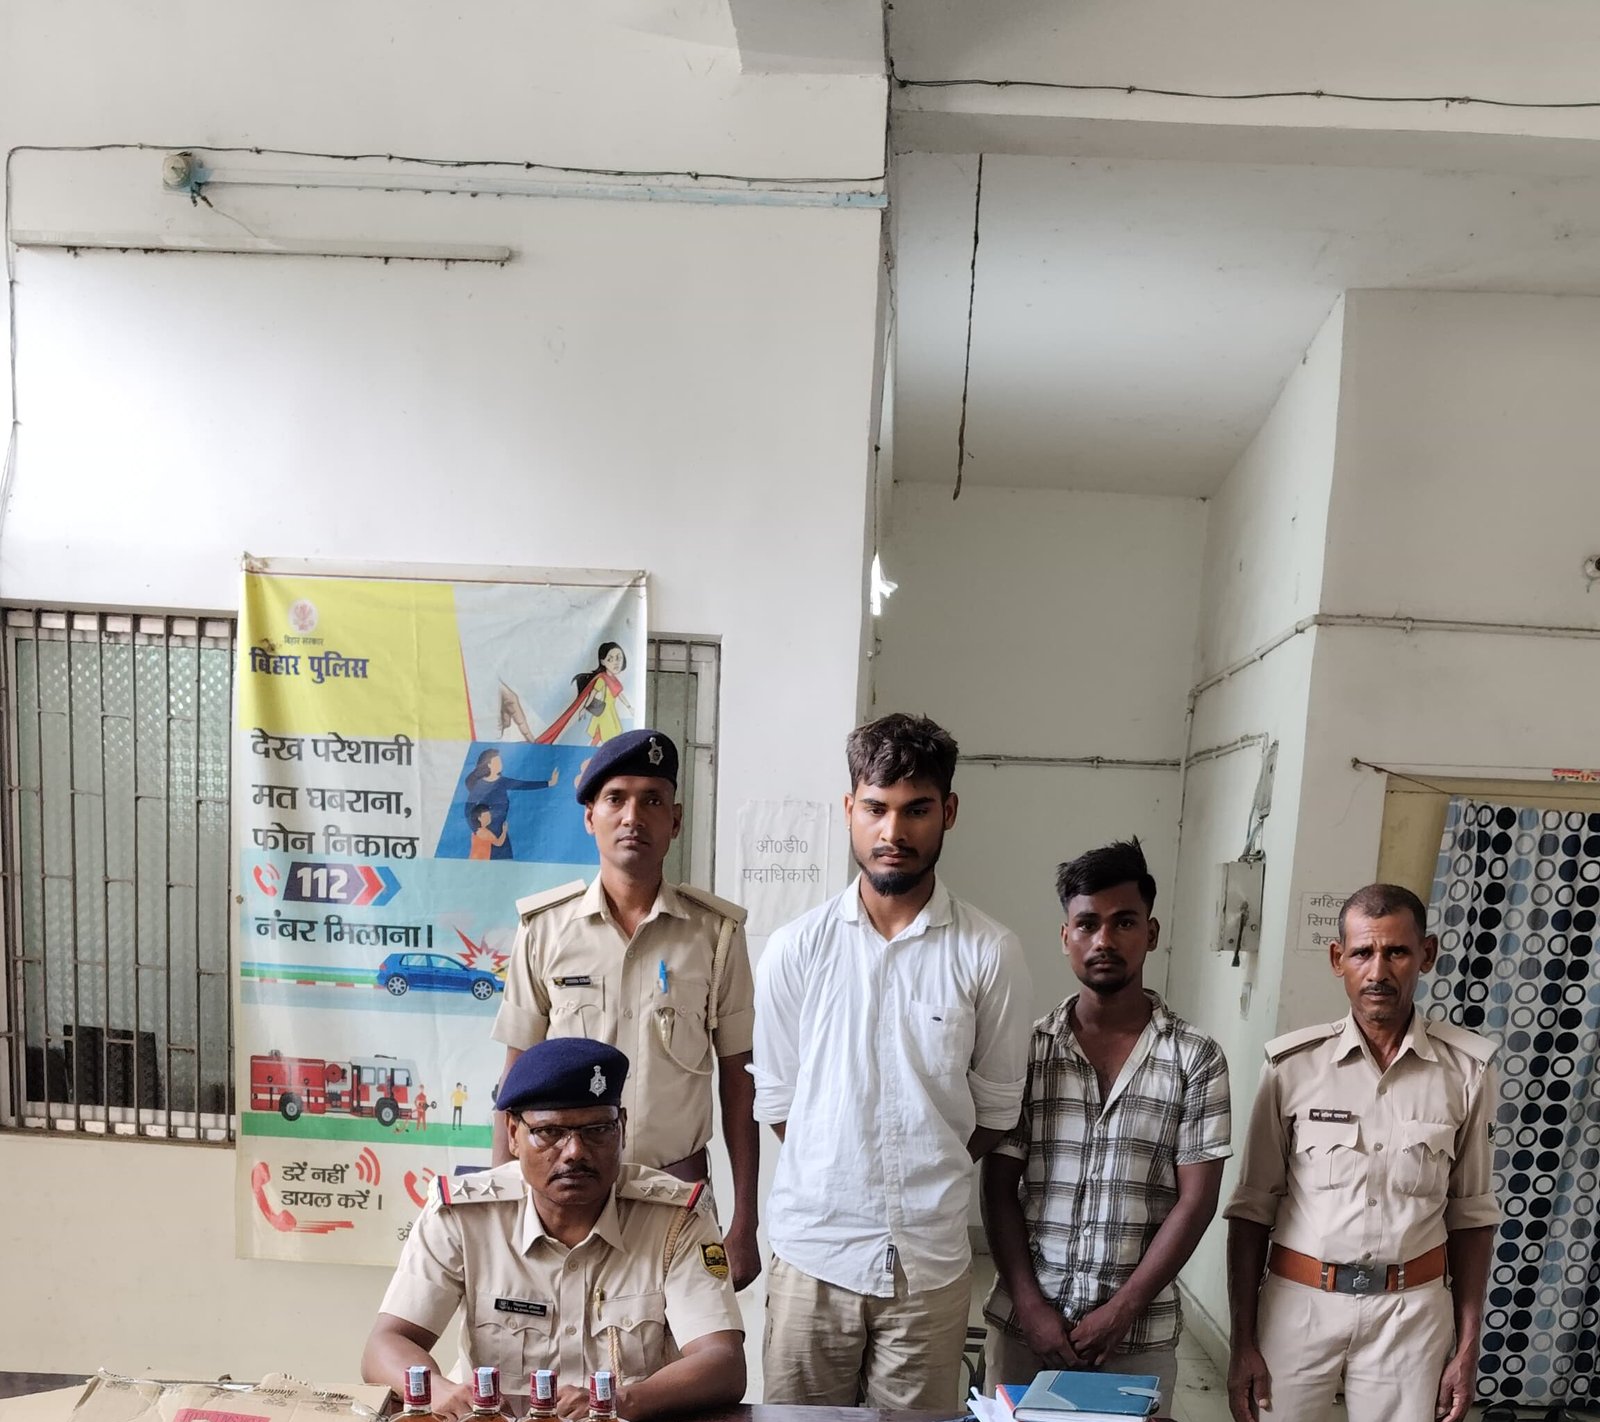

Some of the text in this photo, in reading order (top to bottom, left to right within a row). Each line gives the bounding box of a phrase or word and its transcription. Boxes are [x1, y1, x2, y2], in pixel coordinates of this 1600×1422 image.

[249, 646, 369, 684] बिहार पुलिस
[250, 728, 414, 766] देख परेशानी
[252, 784, 412, 819] मत घबराना,
[253, 822, 419, 859] फोन निकाल
[297, 867, 348, 899] 112
[742, 863, 821, 883] पदाधिकारी
[255, 909, 318, 942] नंबर
[282, 1162, 349, 1184] डरें नहीं
[281, 1190, 331, 1208] डायल
